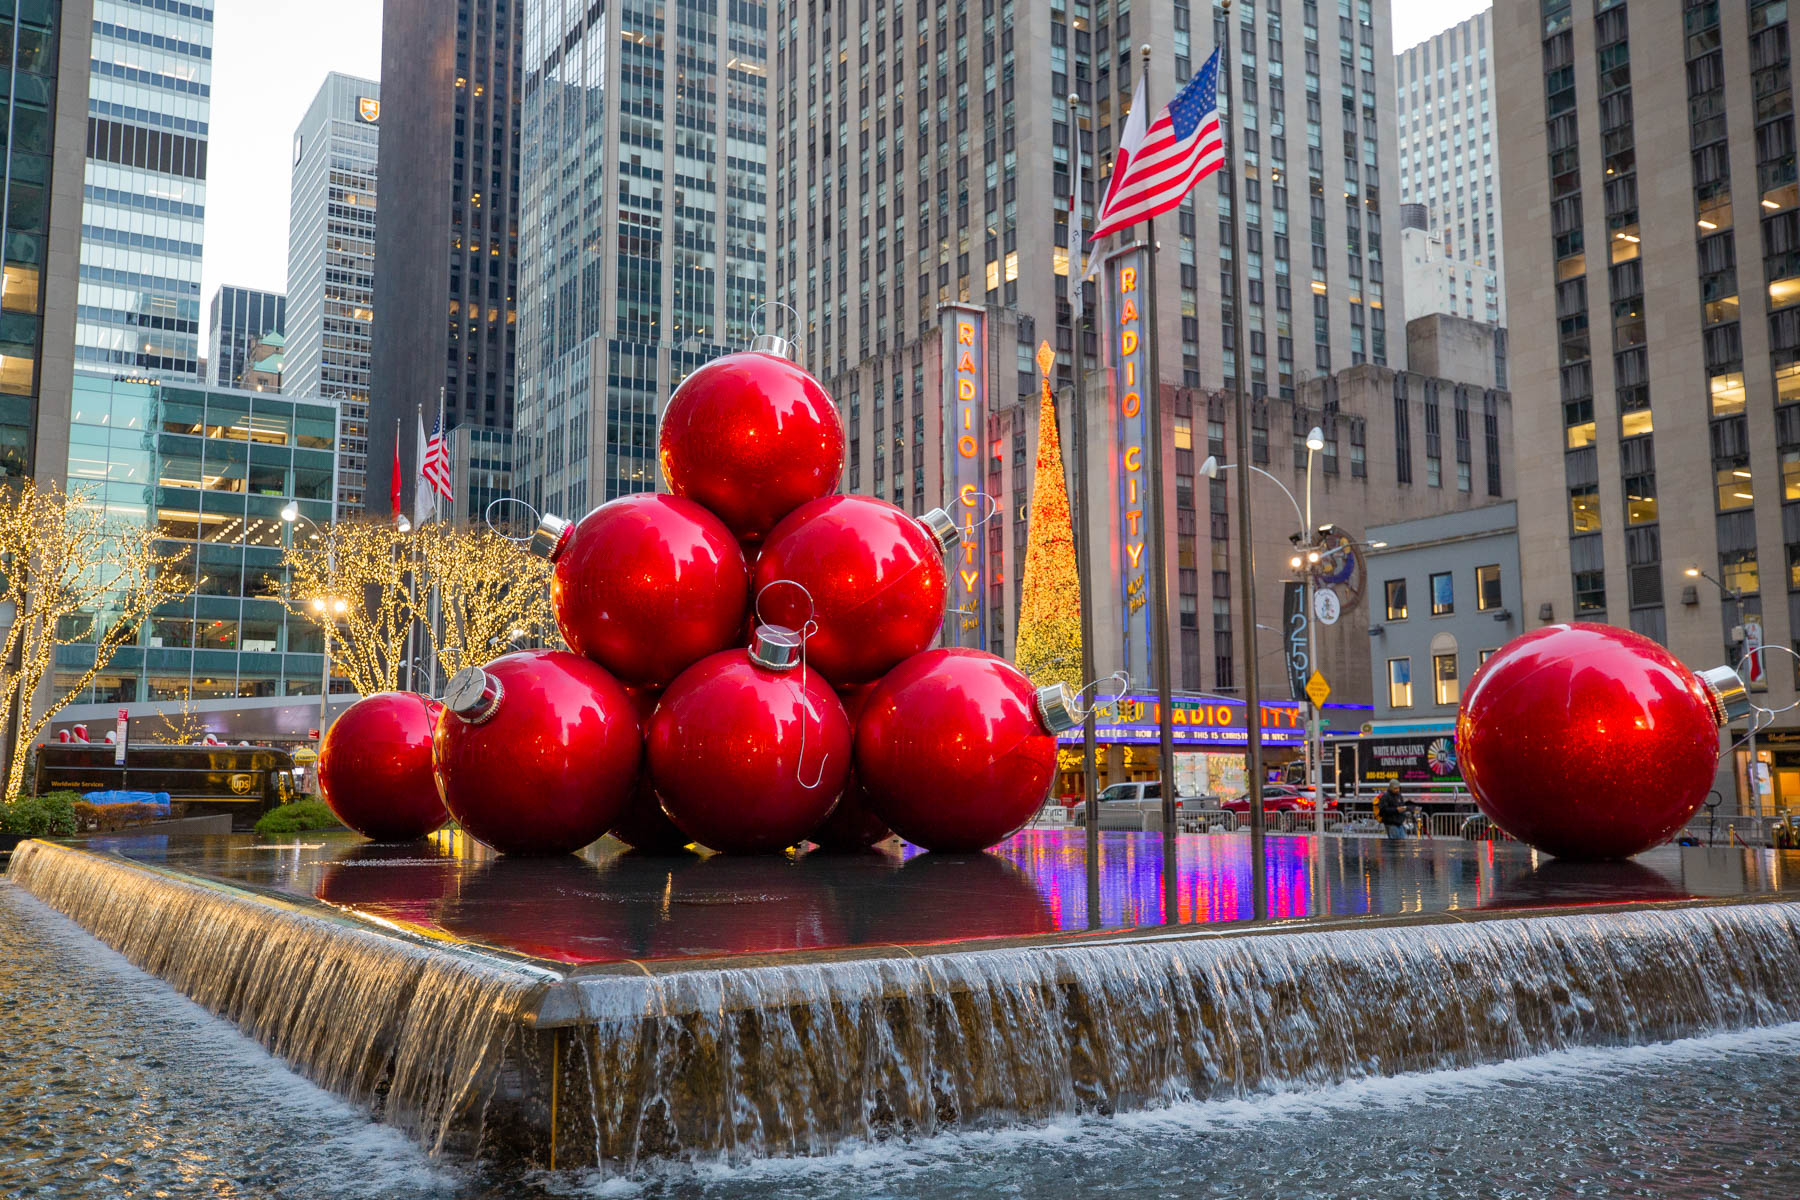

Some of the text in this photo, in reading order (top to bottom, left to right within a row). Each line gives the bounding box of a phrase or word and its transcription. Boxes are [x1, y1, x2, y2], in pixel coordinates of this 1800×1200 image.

[1119, 266, 1144, 569] RADIO CITY
[957, 321, 979, 593] RADIO CITY
[1290, 584, 1308, 699] 1251
[1260, 707, 1299, 728] ITY
[1193, 731, 1209, 739] THIS
[1373, 745, 1425, 756] WHITE PLAINS LINEN
[51, 780, 80, 788] Worldwide
[233, 778, 250, 791] ups
